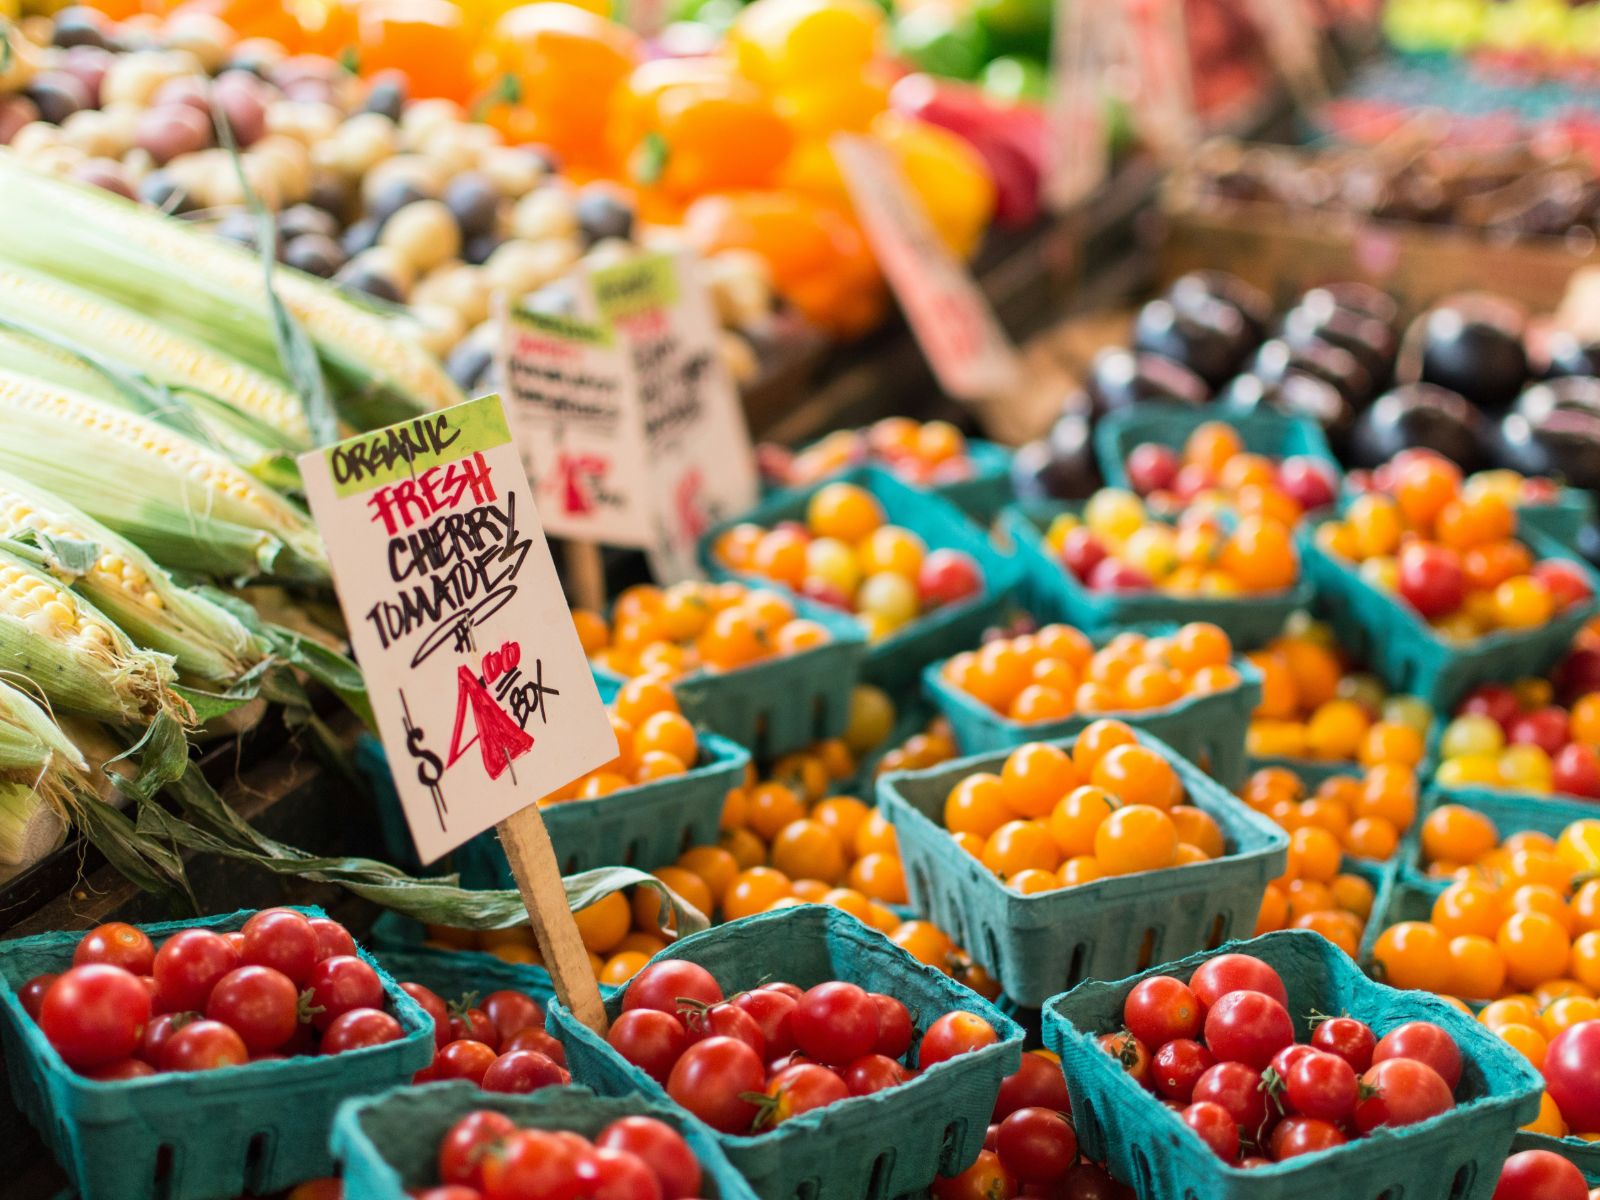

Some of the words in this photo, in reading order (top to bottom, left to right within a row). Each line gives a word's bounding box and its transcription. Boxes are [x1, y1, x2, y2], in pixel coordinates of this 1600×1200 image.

[332, 414, 461, 484] ORGANIC
[367, 451, 498, 536] FRESH
[387, 491, 516, 582] CHERRY
[366, 530, 533, 650] TOMATOES
[509, 659, 560, 730] BOX
